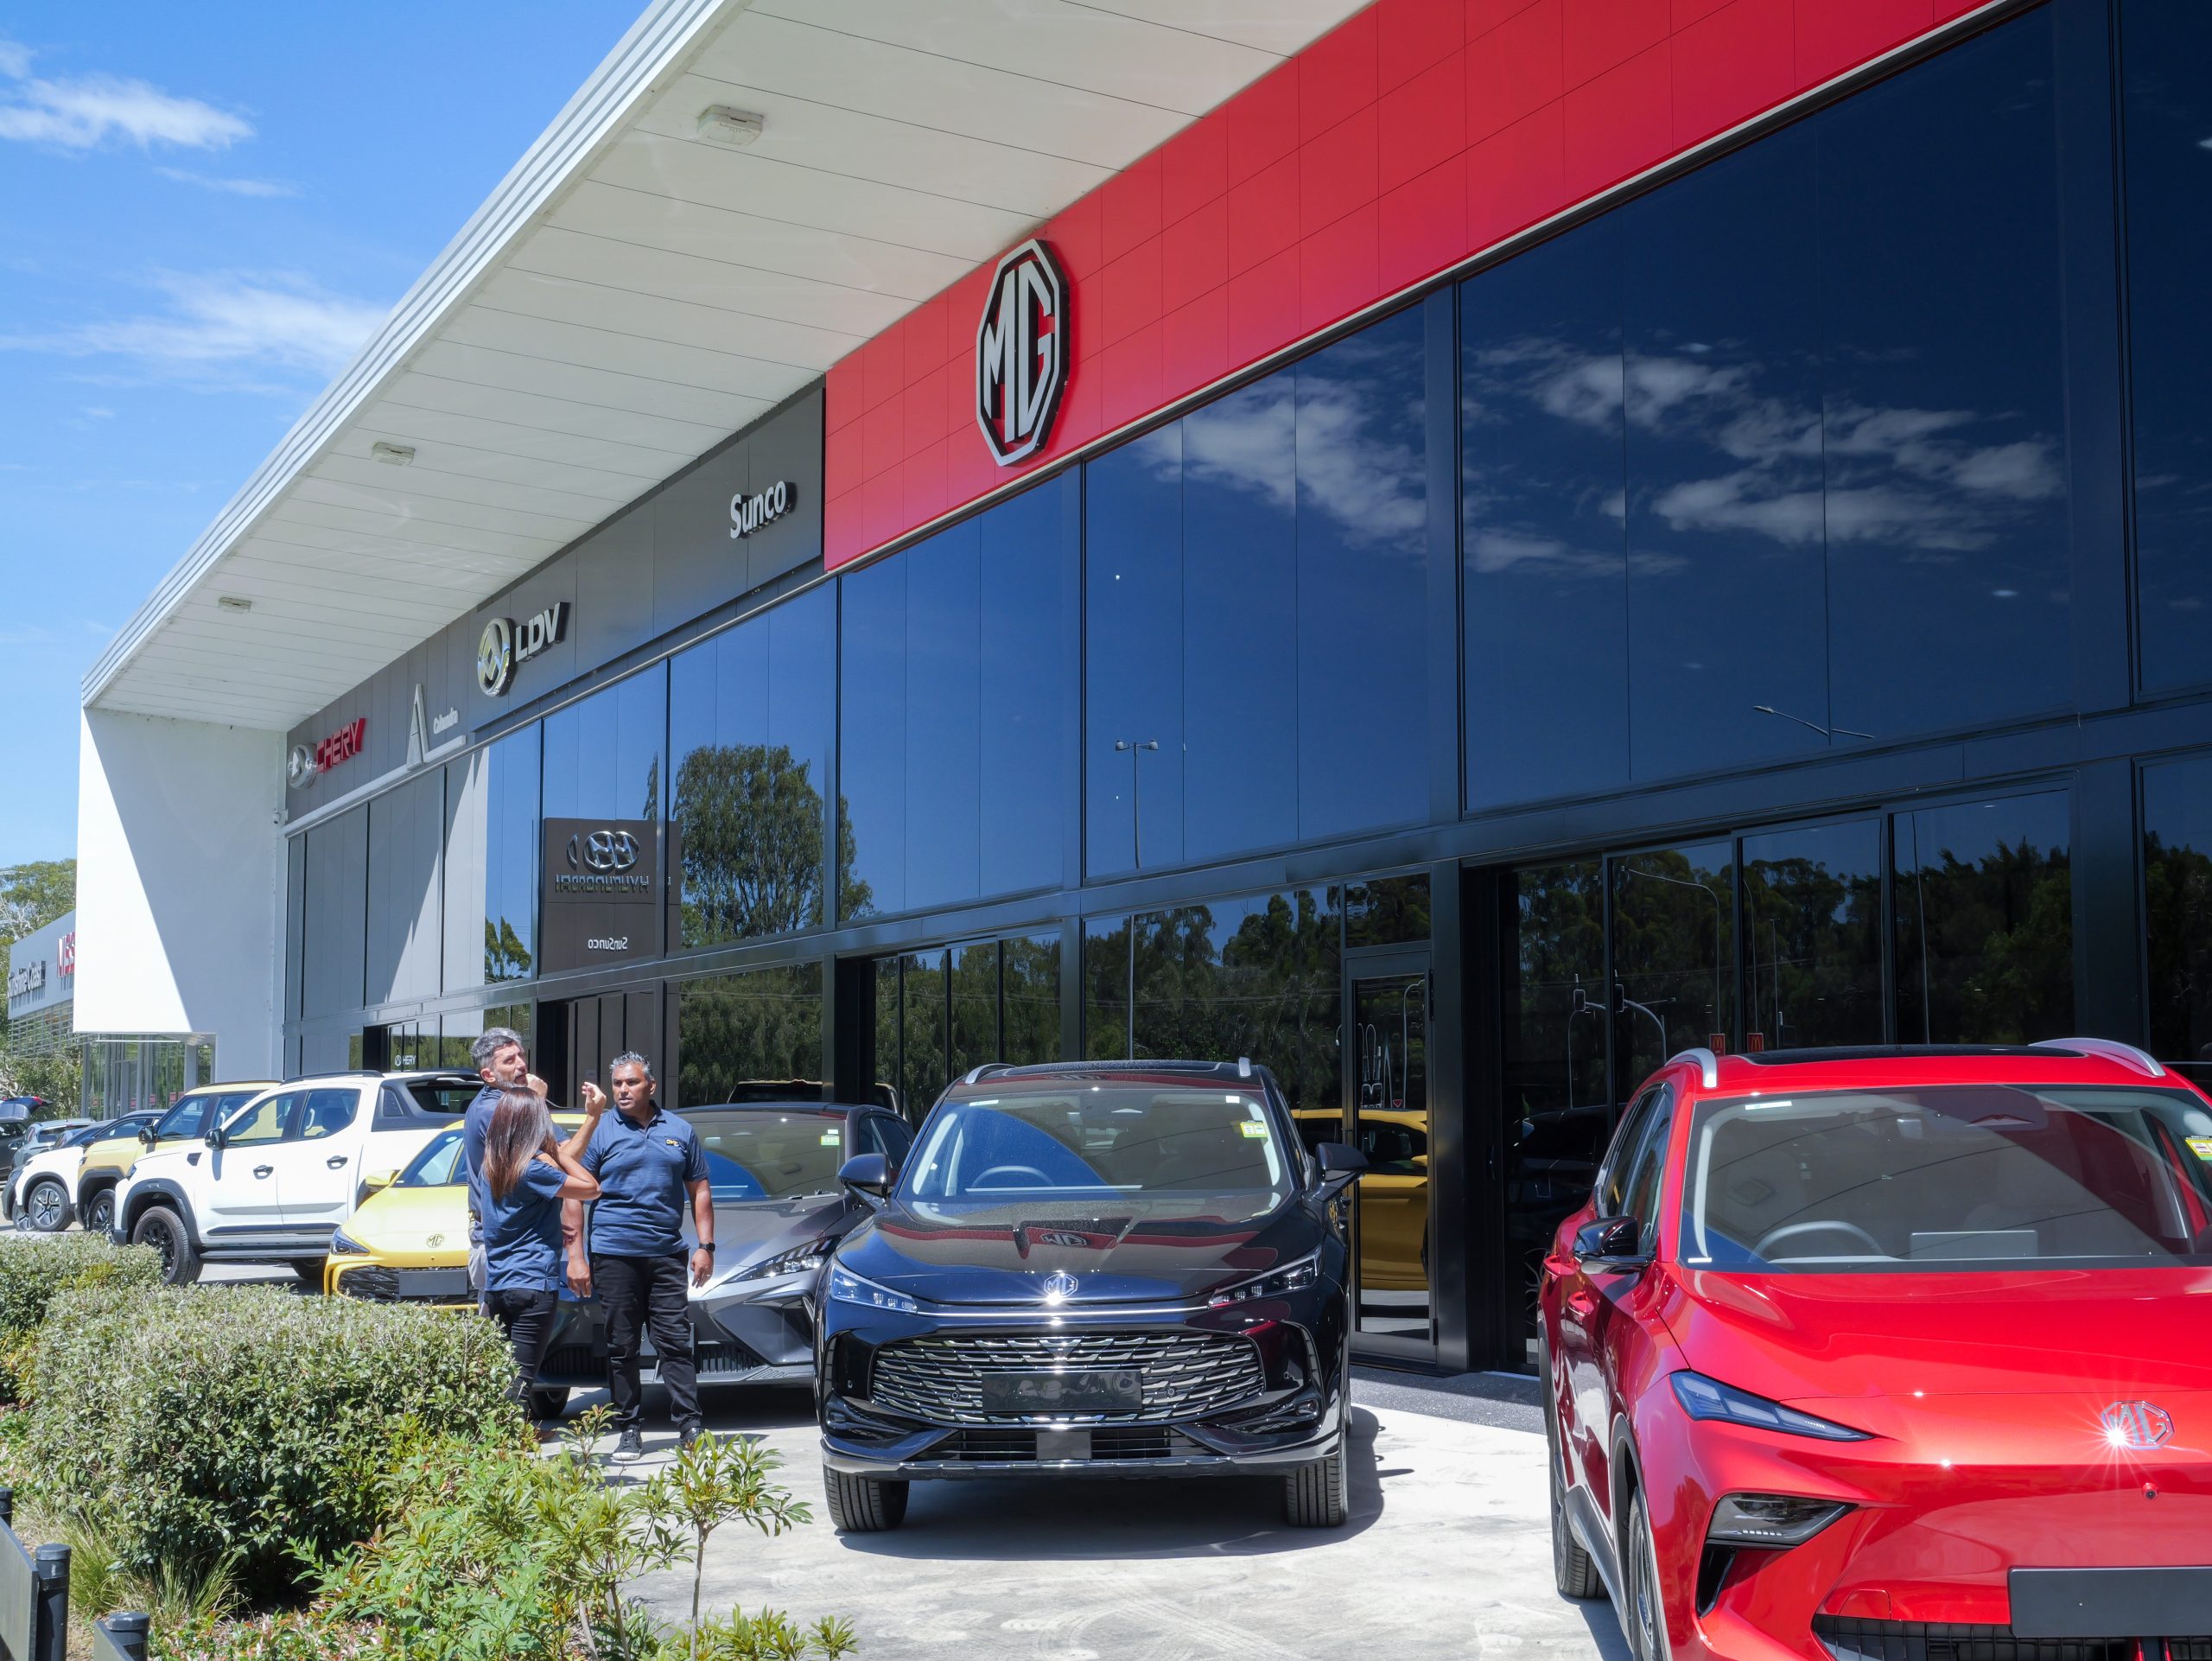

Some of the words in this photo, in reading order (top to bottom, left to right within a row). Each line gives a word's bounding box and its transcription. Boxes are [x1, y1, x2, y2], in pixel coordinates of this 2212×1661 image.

[982, 252, 1054, 449] MG
[730, 480, 786, 539] Sunco
[515, 601, 561, 662] LDV
[317, 718, 363, 773] CHERY
[428, 1235, 443, 1247] MG
[1046, 1276, 1077, 1296] MG
[2107, 1403, 2170, 1446] MG
